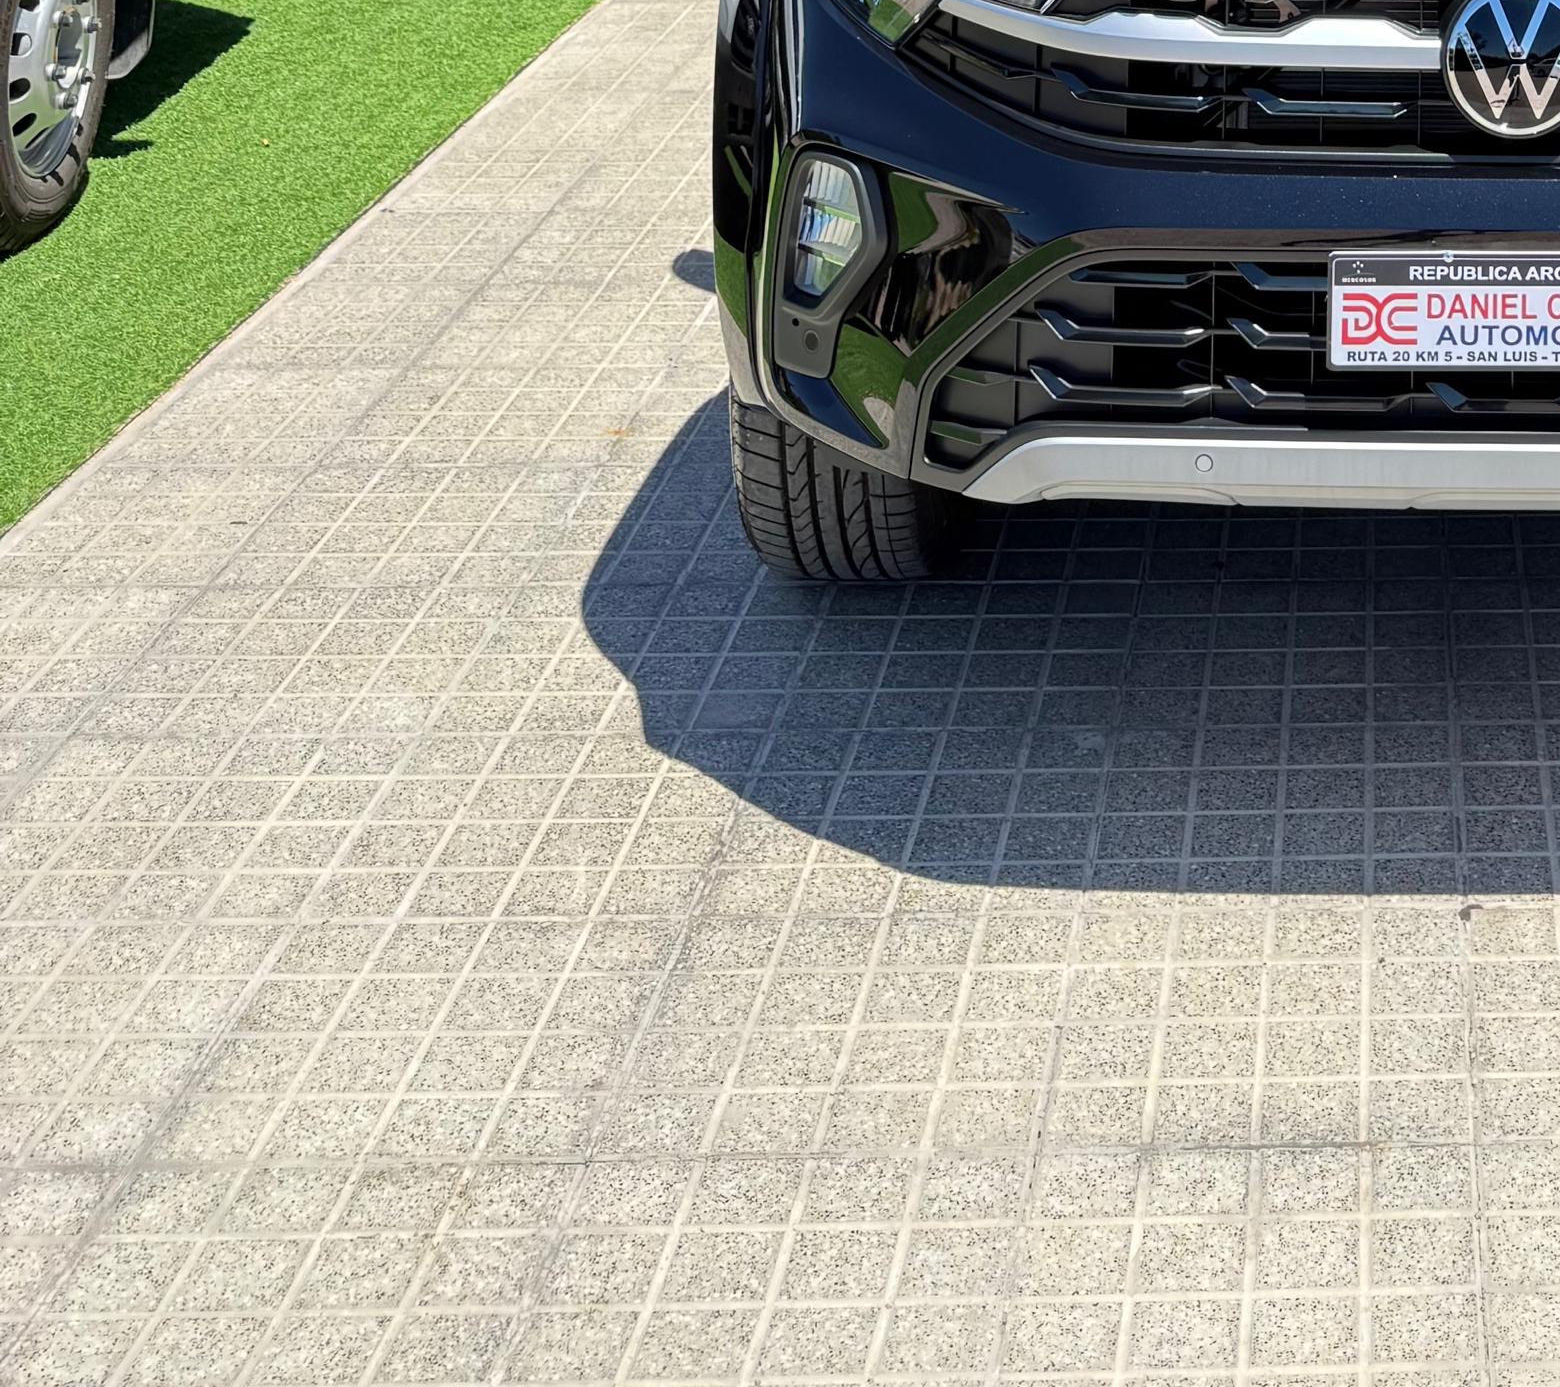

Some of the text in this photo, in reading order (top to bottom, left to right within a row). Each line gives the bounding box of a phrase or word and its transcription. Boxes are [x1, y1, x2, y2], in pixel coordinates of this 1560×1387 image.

[1409, 266, 1522, 281] REPUBLICA
[1427, 293, 1538, 319] DANIEL
[1347, 351, 1387, 362] RUTA
[1392, 351, 1410, 362] 20
[1416, 351, 1439, 362] KM
[1444, 351, 1453, 362] 5
[1467, 351, 1498, 362] SAN
[1503, 351, 1538, 362] LUIS
